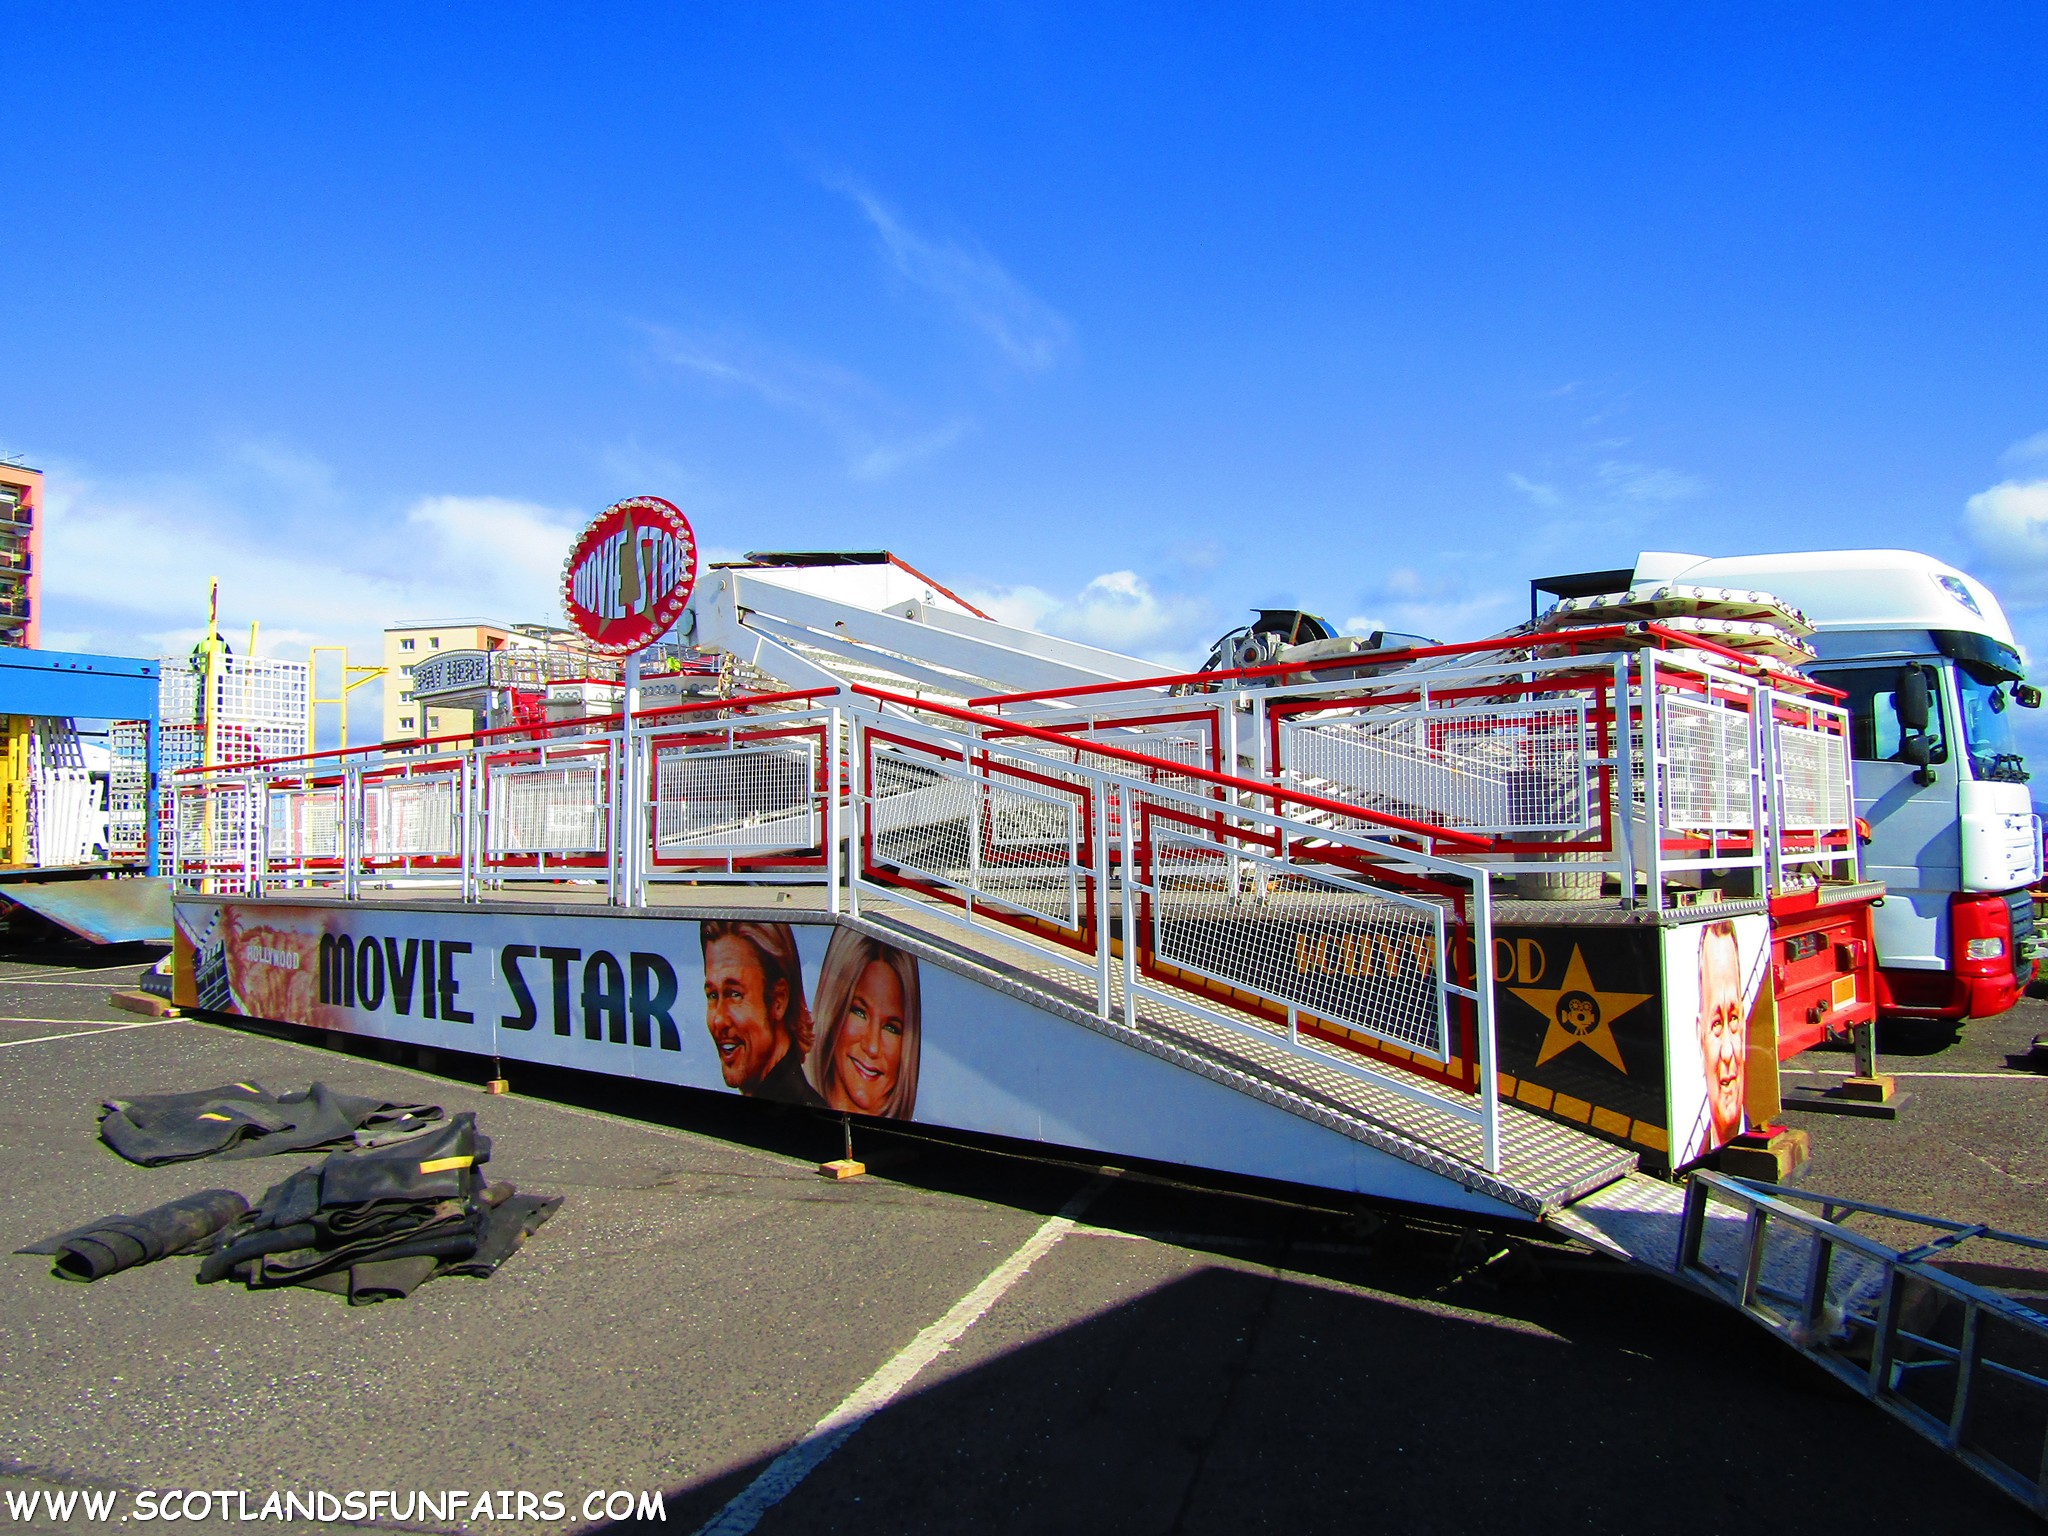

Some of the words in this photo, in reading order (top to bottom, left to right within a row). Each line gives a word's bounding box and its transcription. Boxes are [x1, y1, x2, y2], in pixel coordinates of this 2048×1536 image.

[573, 529, 628, 620] MOVIE
[633, 525, 688, 616] STAR
[417, 662, 443, 690] PAY
[446, 658, 484, 685] HERE
[246, 945, 300, 969] HOLLYWOOD
[319, 933, 474, 1024] MOVIE
[501, 944, 681, 1051] STAR
